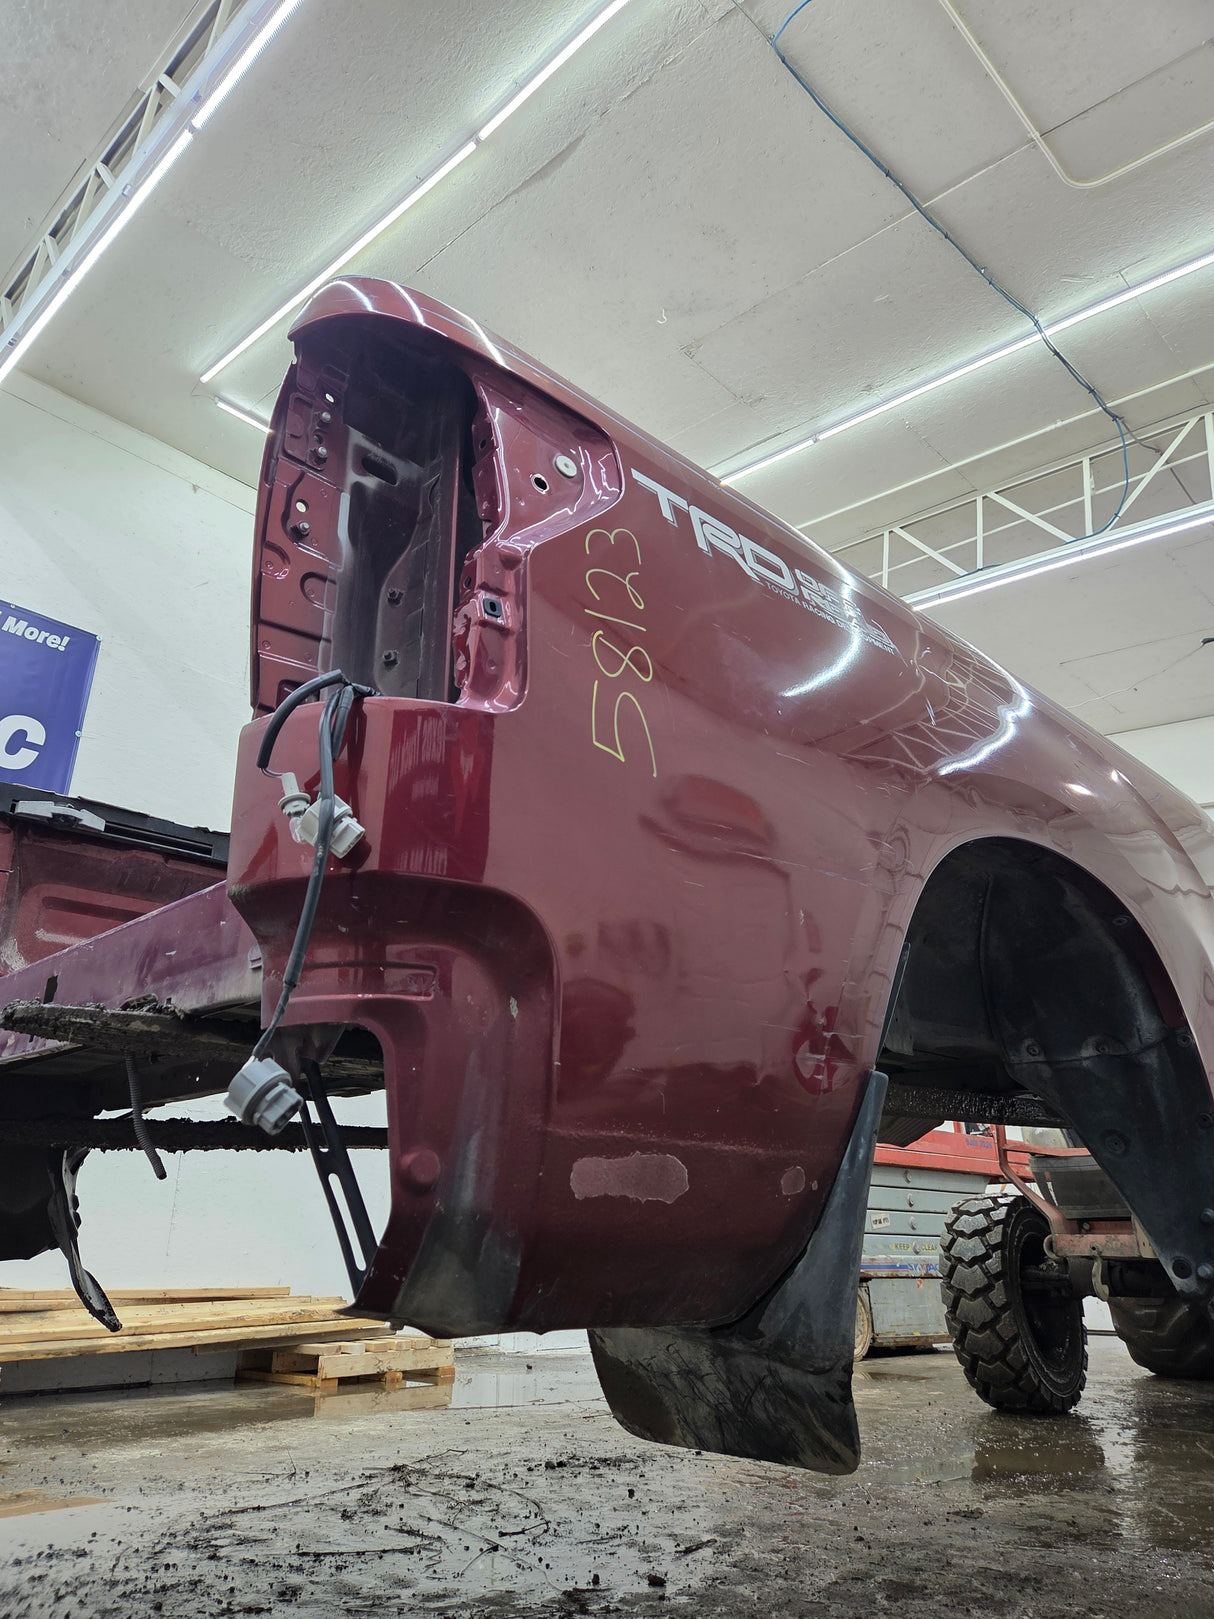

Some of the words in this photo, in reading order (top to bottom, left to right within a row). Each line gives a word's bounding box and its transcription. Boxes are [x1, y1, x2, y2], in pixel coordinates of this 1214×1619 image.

[631, 468, 799, 595] TRD
[1, 615, 71, 651] More!
[765, 581, 801, 605] TOYOTA
[584, 528, 658, 778] 58123
